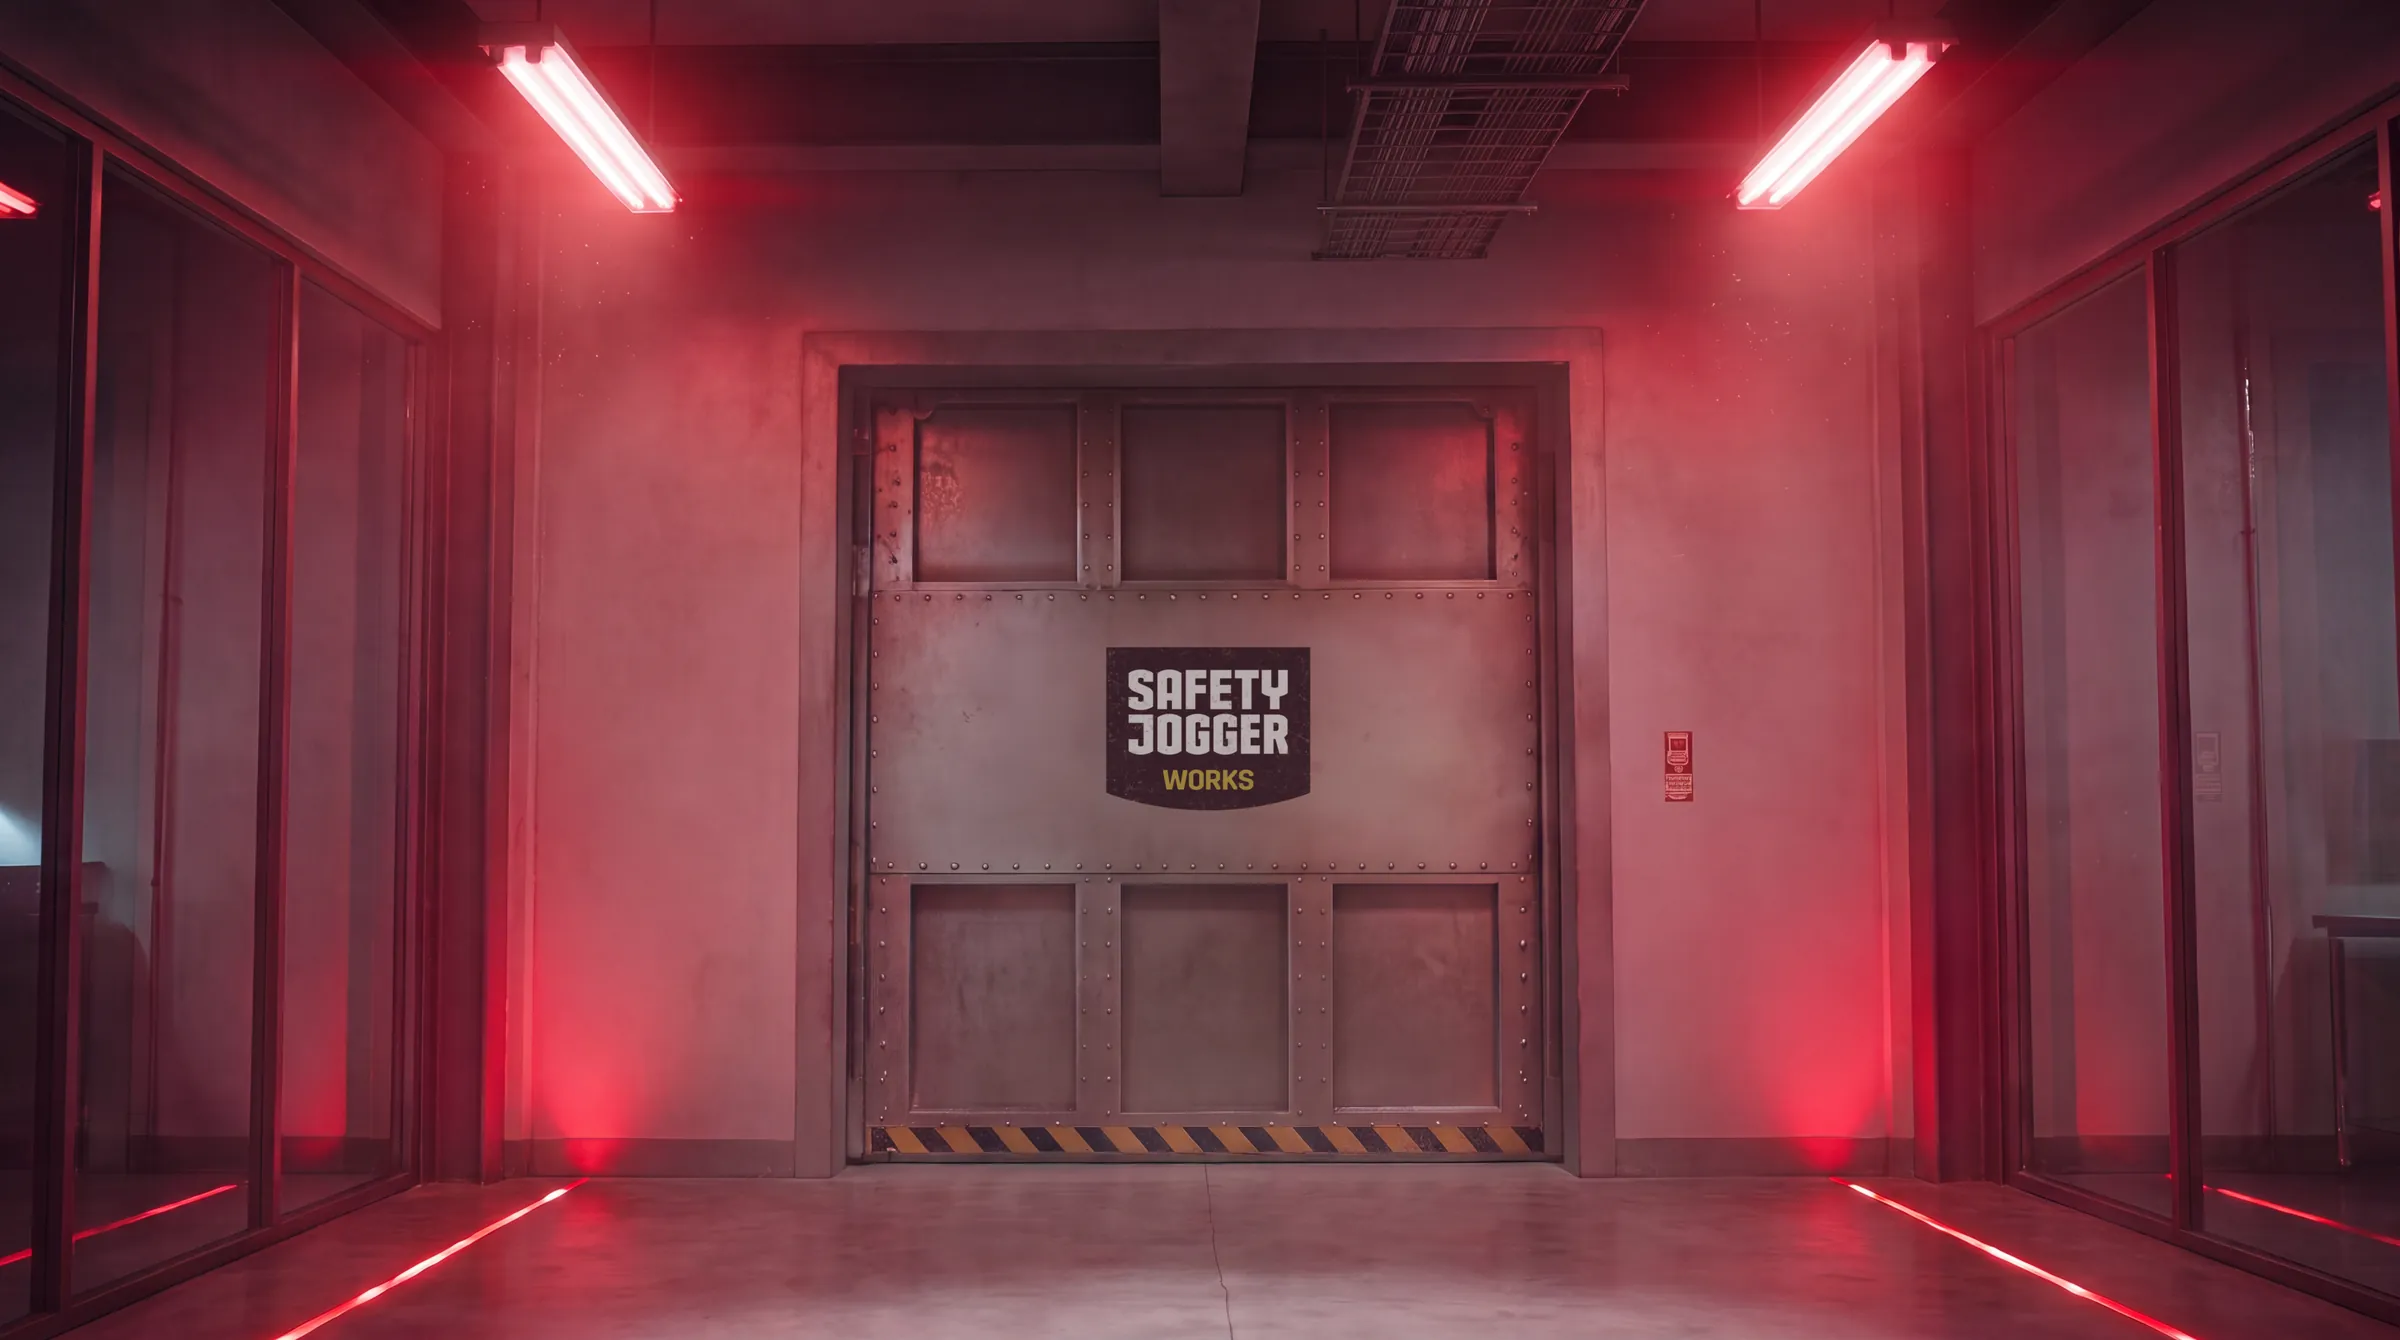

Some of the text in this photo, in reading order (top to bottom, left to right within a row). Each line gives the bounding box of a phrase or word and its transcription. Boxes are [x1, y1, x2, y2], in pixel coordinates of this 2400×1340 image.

[1128, 669, 1289, 710] SAFETY
[1128, 713, 1289, 755] JOGGER
[1163, 769, 1254, 790] WORKS
